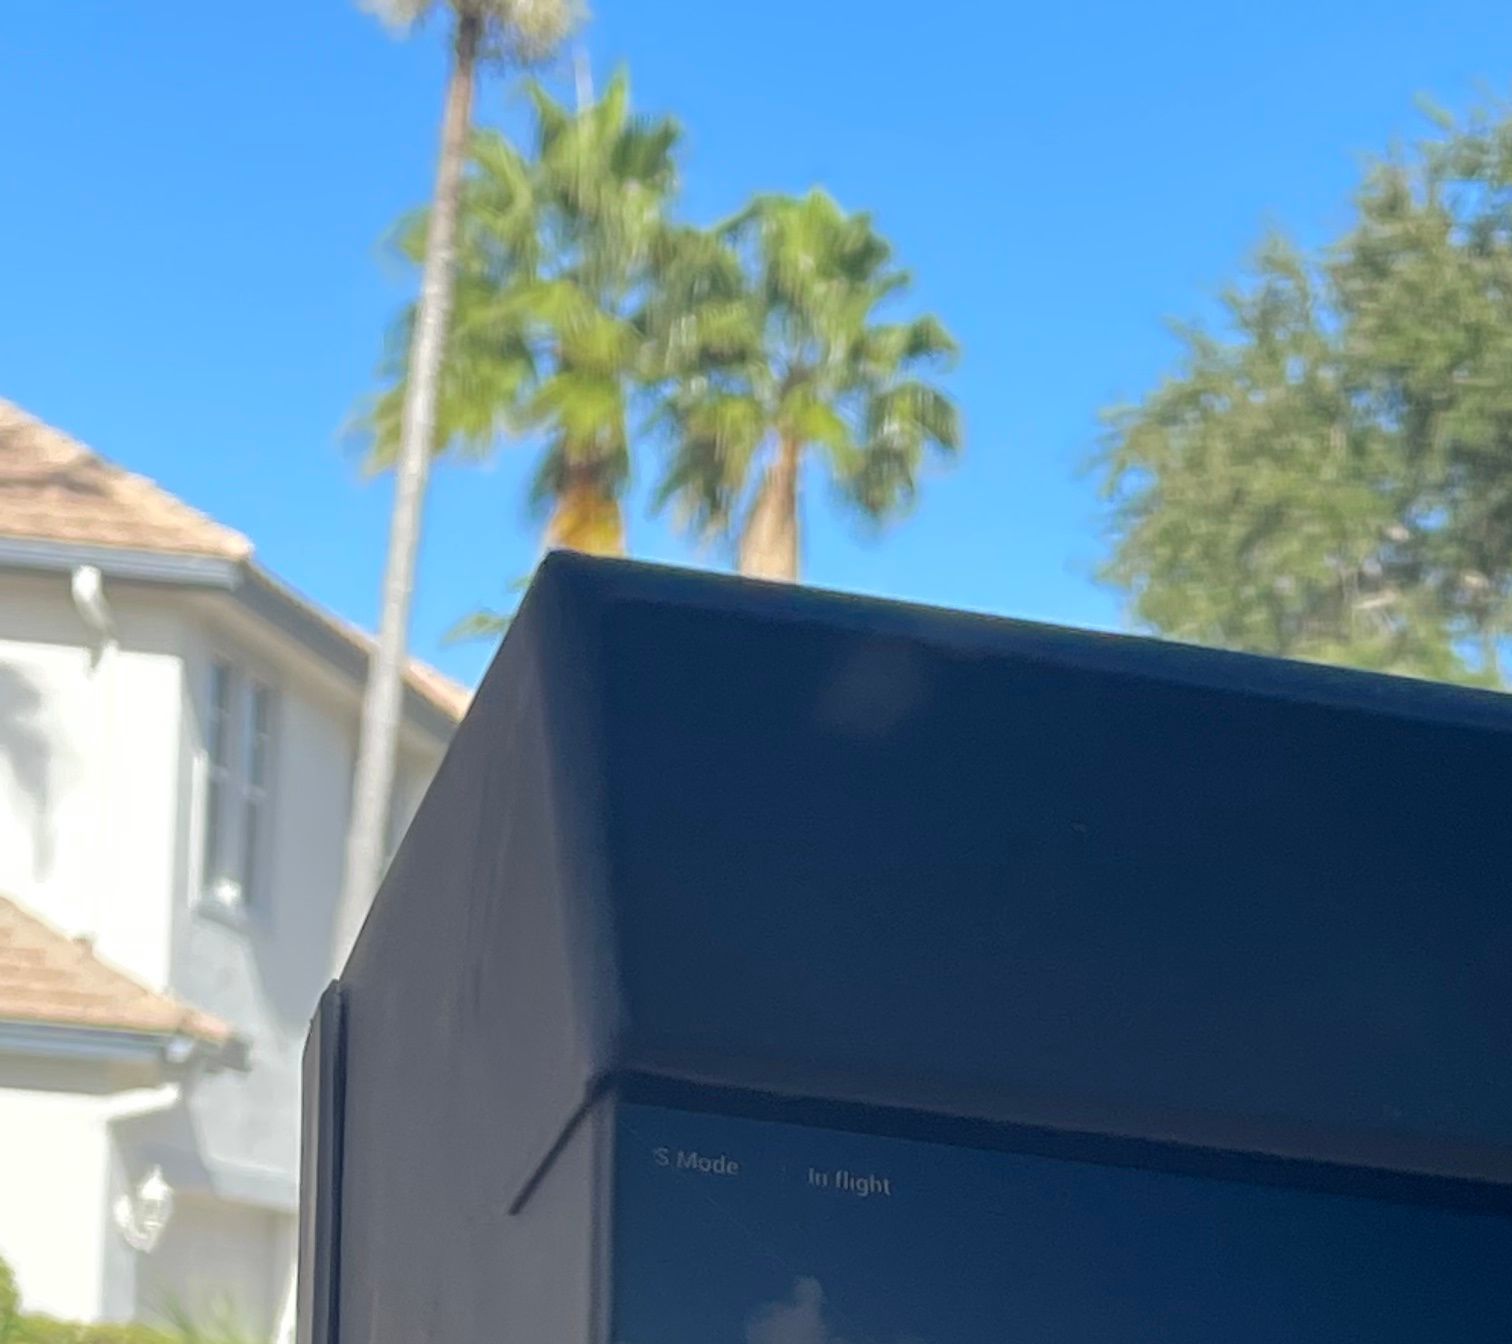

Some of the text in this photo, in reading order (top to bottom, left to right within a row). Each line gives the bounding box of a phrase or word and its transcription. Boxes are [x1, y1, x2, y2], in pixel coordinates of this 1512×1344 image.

[653, 1147, 740, 1176] S Mode
[808, 1167, 892, 1197] In flight
